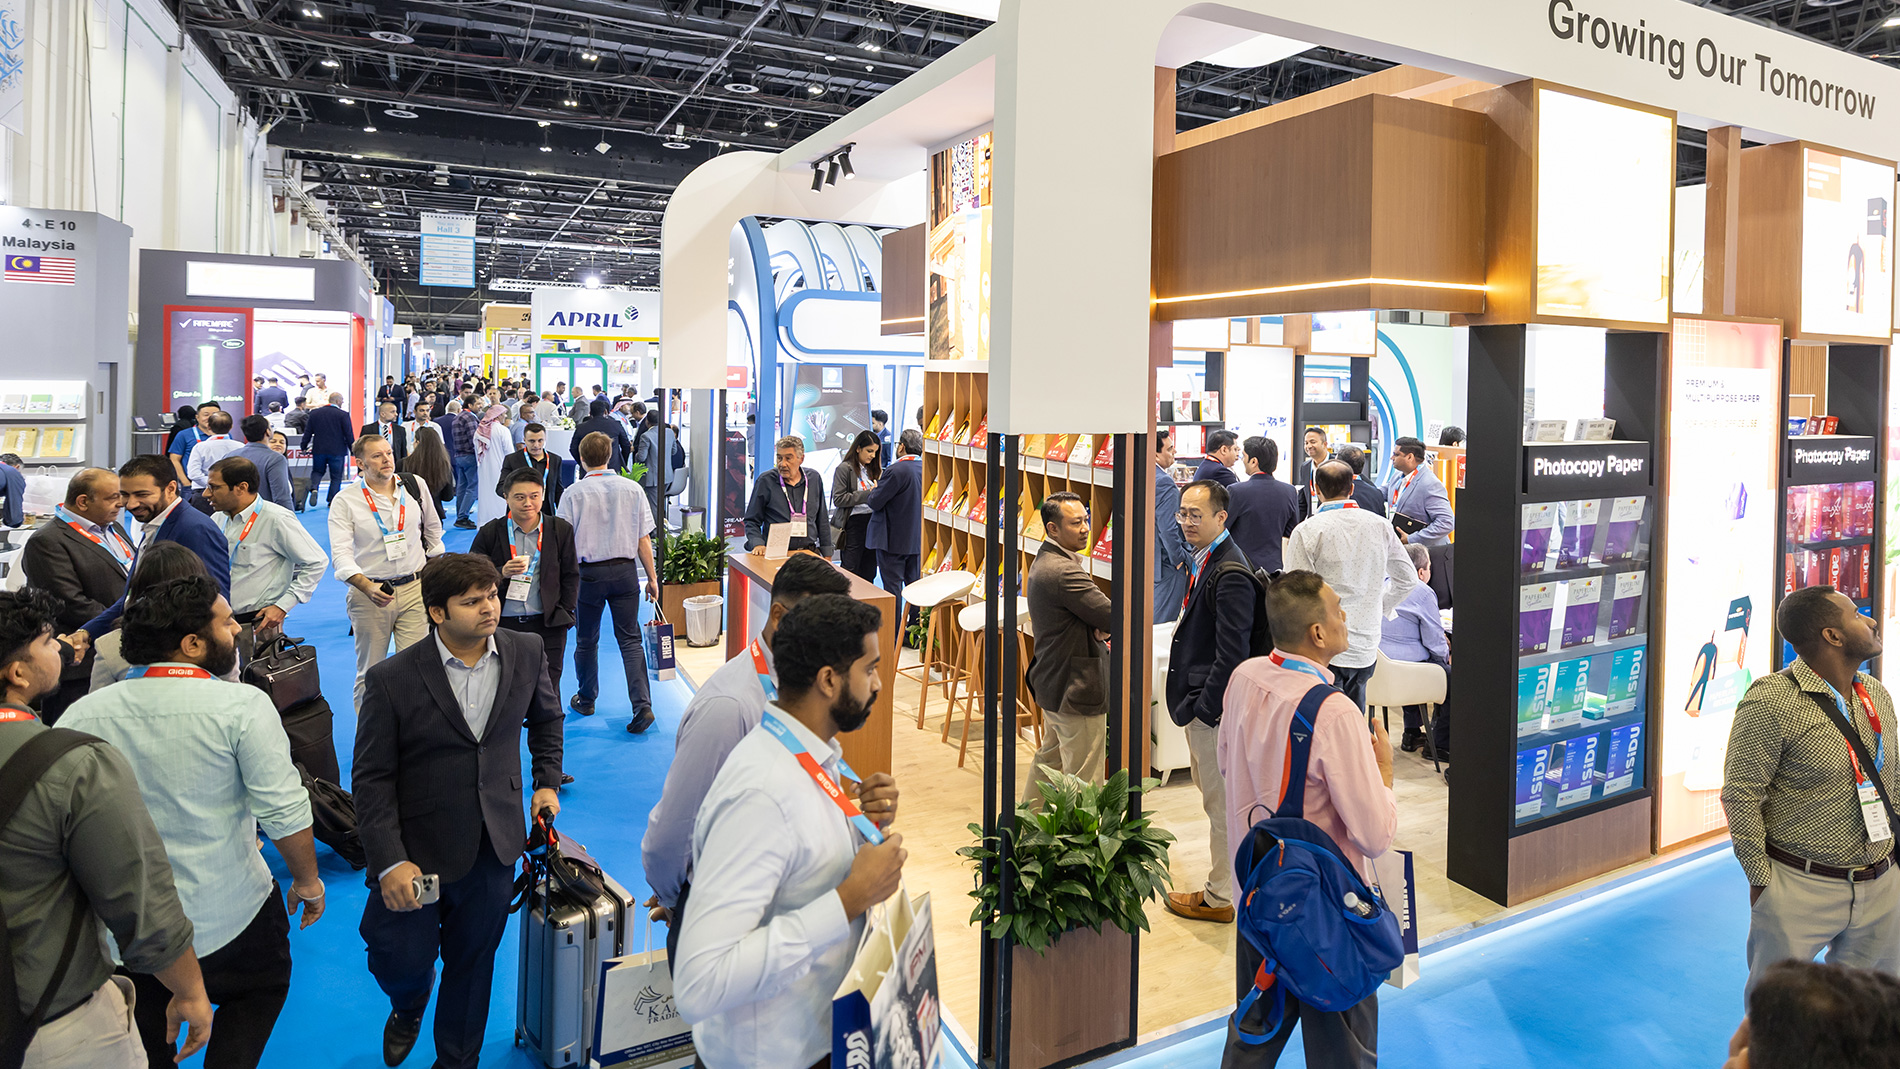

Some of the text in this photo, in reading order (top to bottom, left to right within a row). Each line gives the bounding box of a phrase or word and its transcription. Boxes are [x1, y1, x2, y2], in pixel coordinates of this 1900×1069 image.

[1549, 0, 1876, 120] Growing Our Tomorrow
[22, 218, 31, 229] 4
[45, 219, 55, 230] E
[60, 220, 77, 231] 10
[2, 235, 76, 252] Malaysia
[547, 311, 623, 328] APRIL
[615, 342, 630, 352] MP
[1795, 446, 1871, 466] Photocopy Paper
[1534, 455, 1644, 477] Photocopy Paper
[648, 1004, 677, 1018] KA
